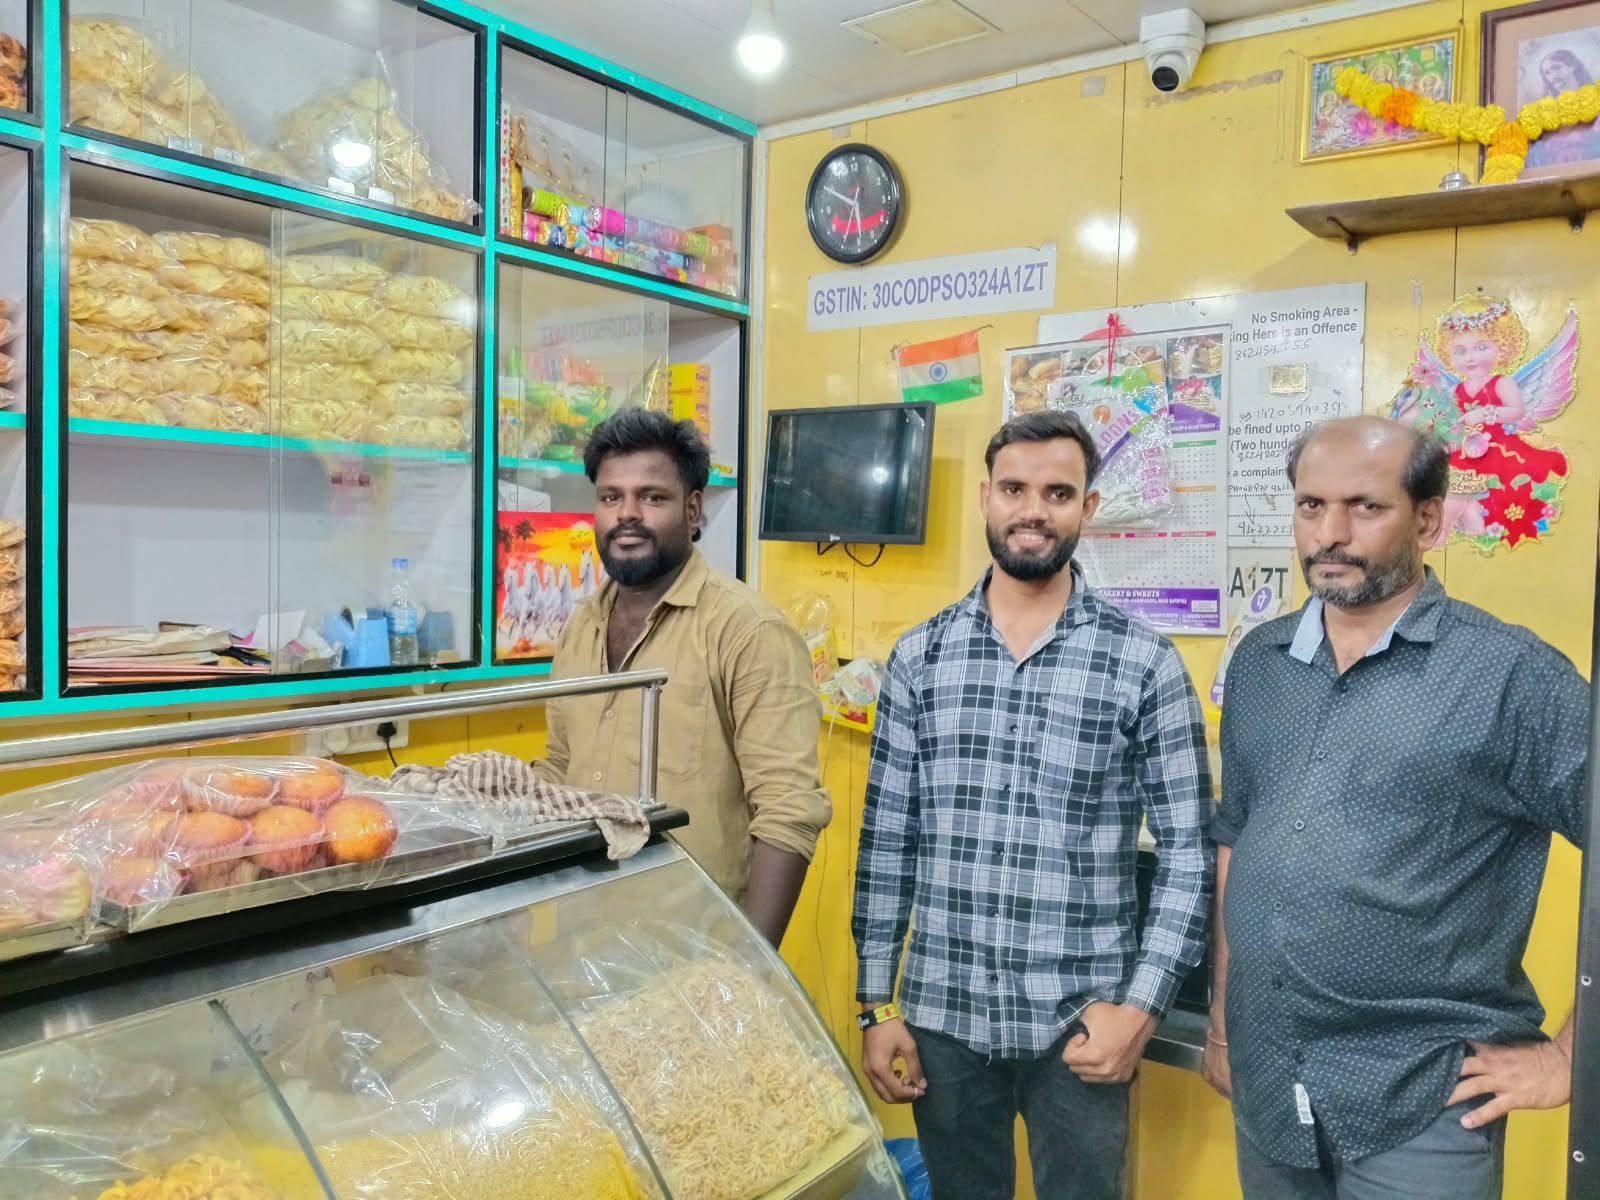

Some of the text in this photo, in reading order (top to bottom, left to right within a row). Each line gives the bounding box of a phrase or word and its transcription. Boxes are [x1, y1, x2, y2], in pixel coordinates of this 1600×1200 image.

[813, 285, 868, 316] GSTIN:
[1251, 313, 1267, 325] No
[1270, 307, 1320, 322] Smoking
[1322, 305, 1350, 318] Area
[1252, 329, 1276, 341] Here
[1282, 326, 1291, 337] is
[1294, 326, 1309, 337] an
[1311, 321, 1357, 335] Offence
[1228, 425, 1242, 436] be
[1244, 422, 1272, 434] fined
[1275, 422, 1301, 435] upto
[1230, 437, 1291, 454] (Two hund
[1232, 470, 1239, 478] a
